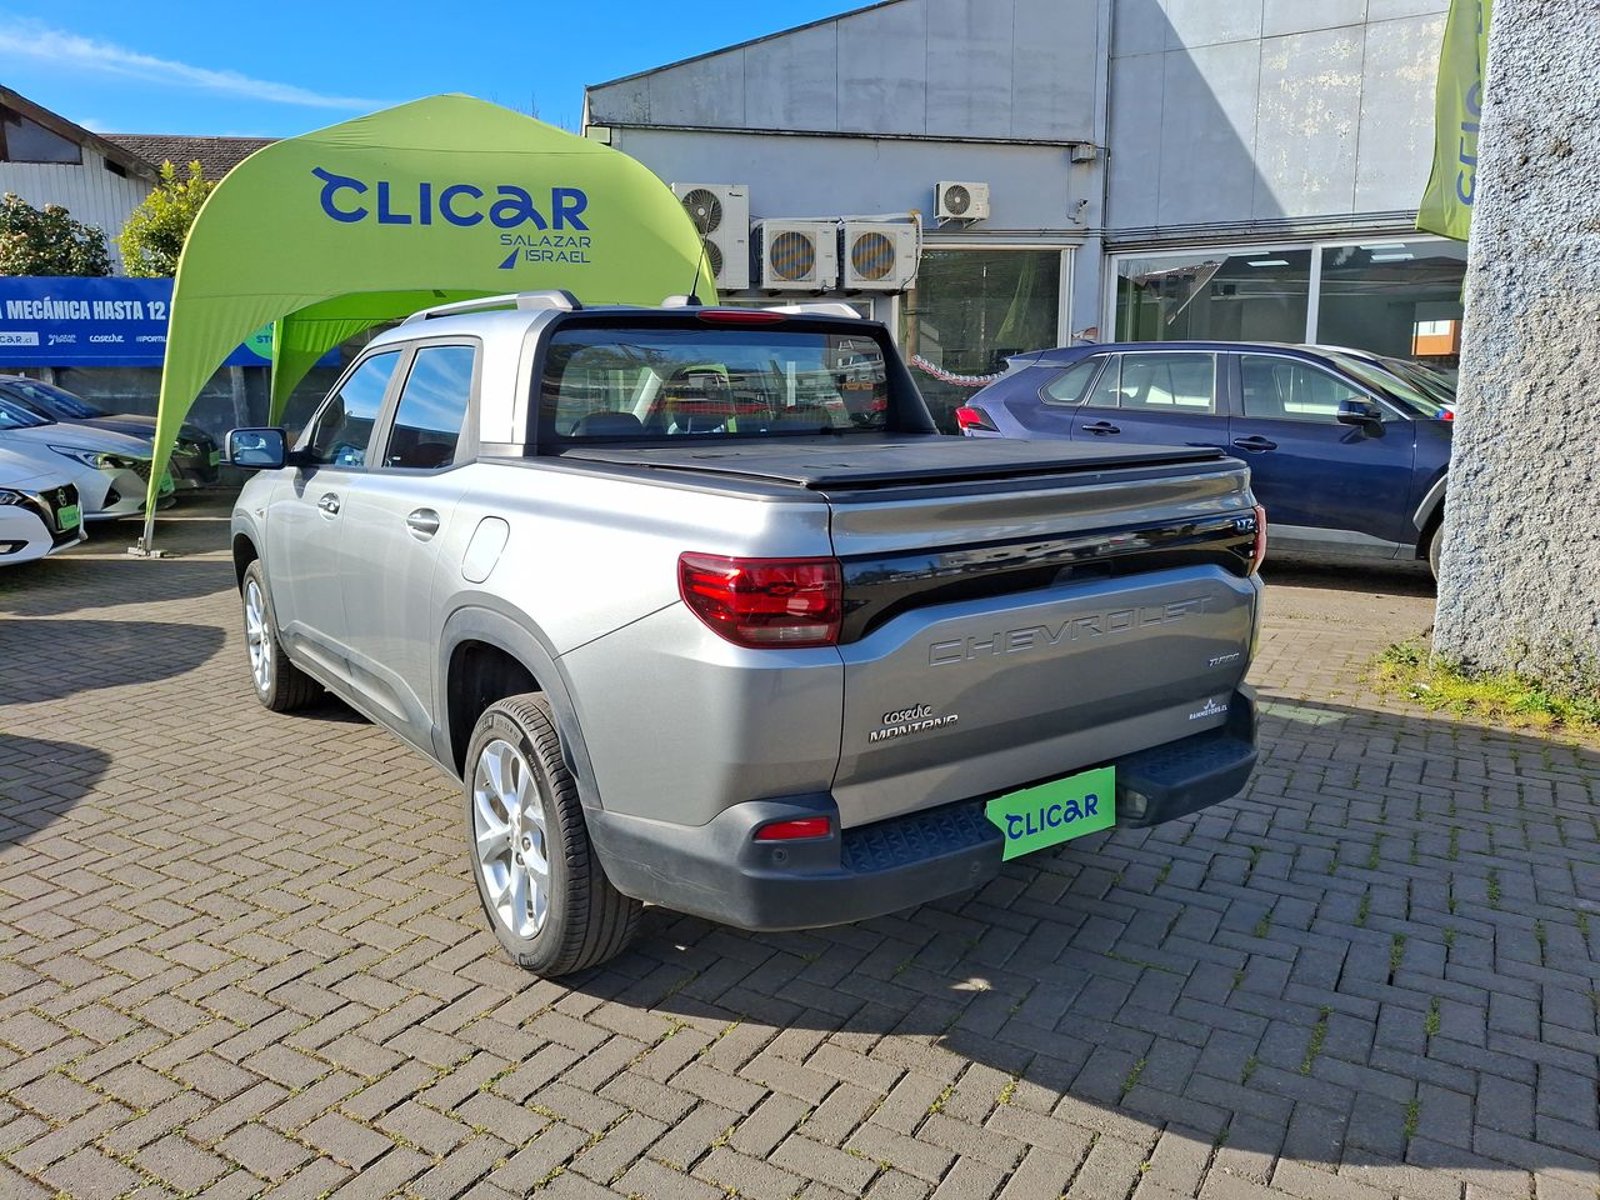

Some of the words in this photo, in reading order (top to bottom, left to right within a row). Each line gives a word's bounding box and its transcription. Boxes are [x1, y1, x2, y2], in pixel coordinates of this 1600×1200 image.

[500, 234, 591, 248] SALAZAR
[525, 250, 591, 263] ISRAEL
[6, 296, 90, 320] MECÁNICA
[93, 301, 144, 320] HASTA
[147, 301, 166, 320] 12
[929, 597, 1213, 667] CHEVROLET
[882, 704, 932, 725] coseche
[869, 714, 959, 742] MONTANA
